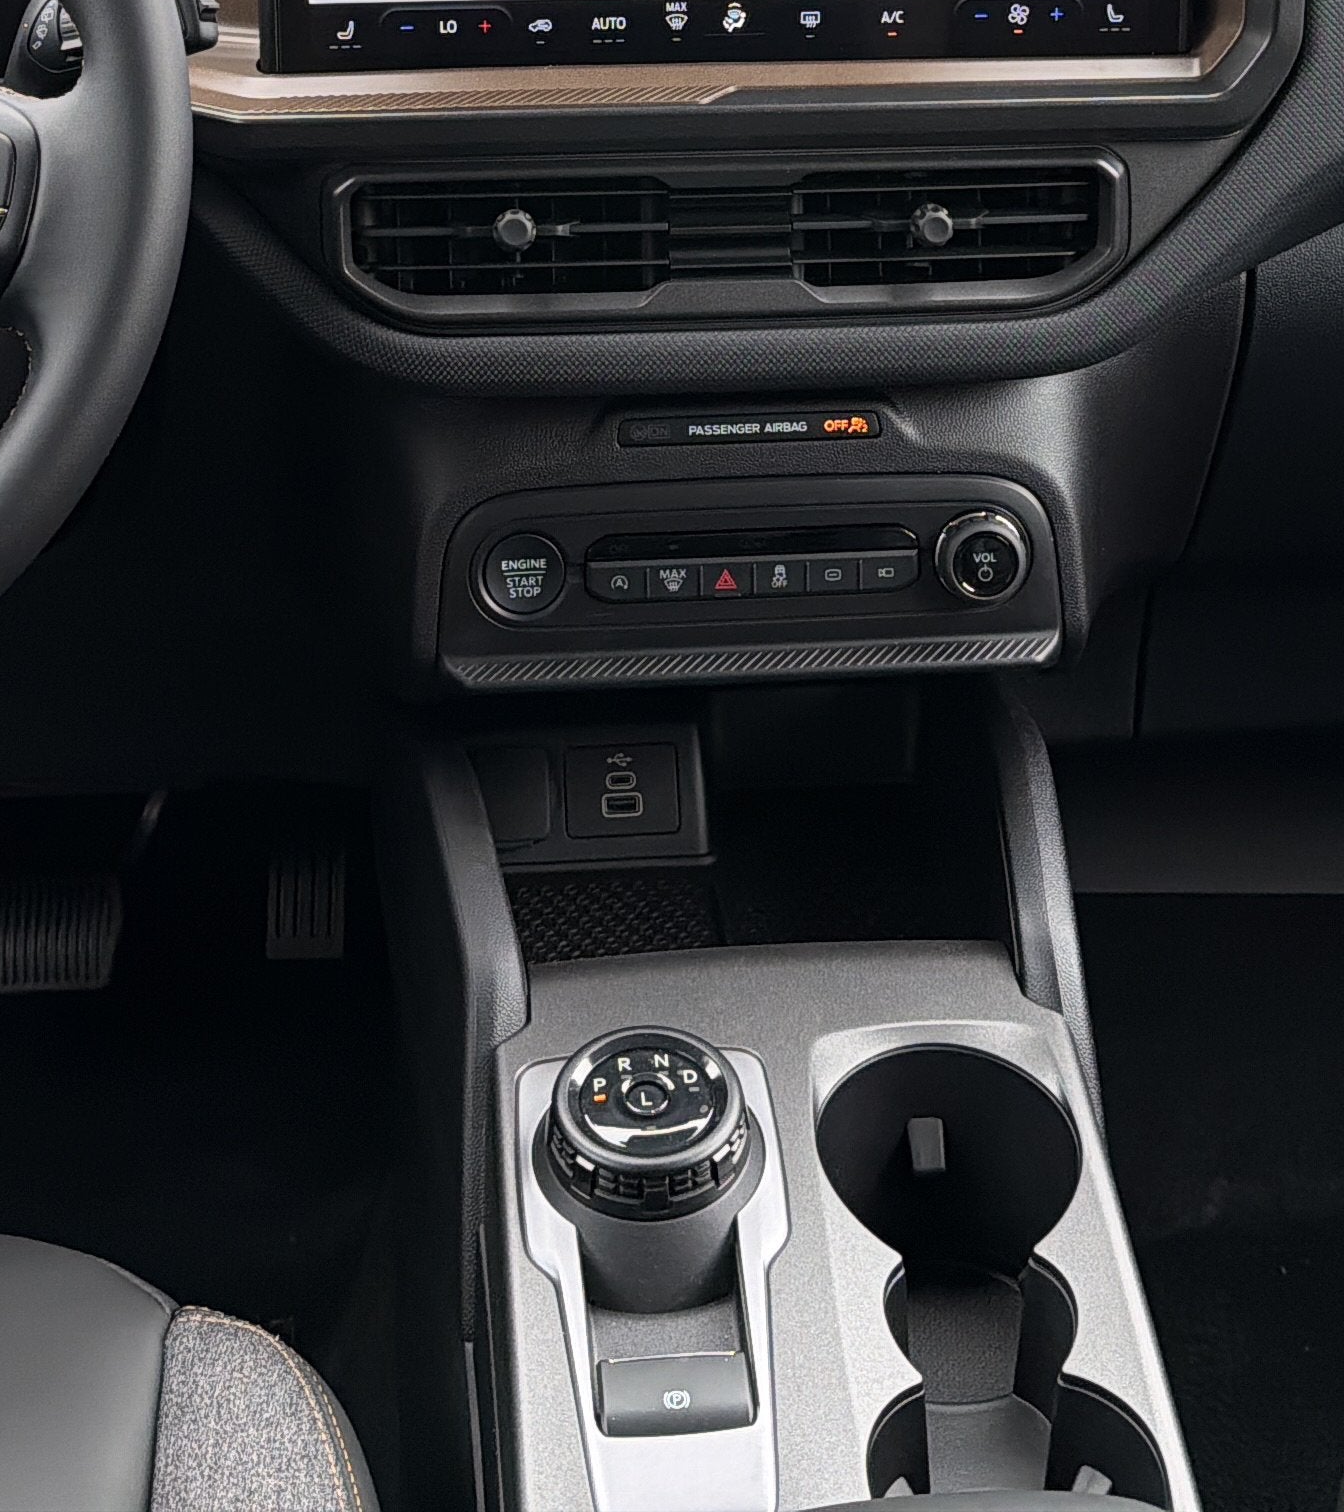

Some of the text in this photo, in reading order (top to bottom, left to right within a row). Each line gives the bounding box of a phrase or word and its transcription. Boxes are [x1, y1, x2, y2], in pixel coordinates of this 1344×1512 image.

[665, 2, 687, 12] MAX
[591, 17, 626, 31] AUTO
[881, 10, 904, 25] A/C
[439, 19, 457, 34] LO
[688, 421, 808, 436] PASSENGER AIRBAG
[823, 419, 848, 433] OFF
[972, 551, 997, 564] VOL
[501, 558, 547, 571] ENGINE
[659, 568, 687, 580] MAX
[506, 575, 544, 588] START
[771, 580, 788, 589] OFF
[509, 586, 541, 599] STOP
[593, 1053, 698, 1092] P R N D
[640, 1091, 653, 1106] L
